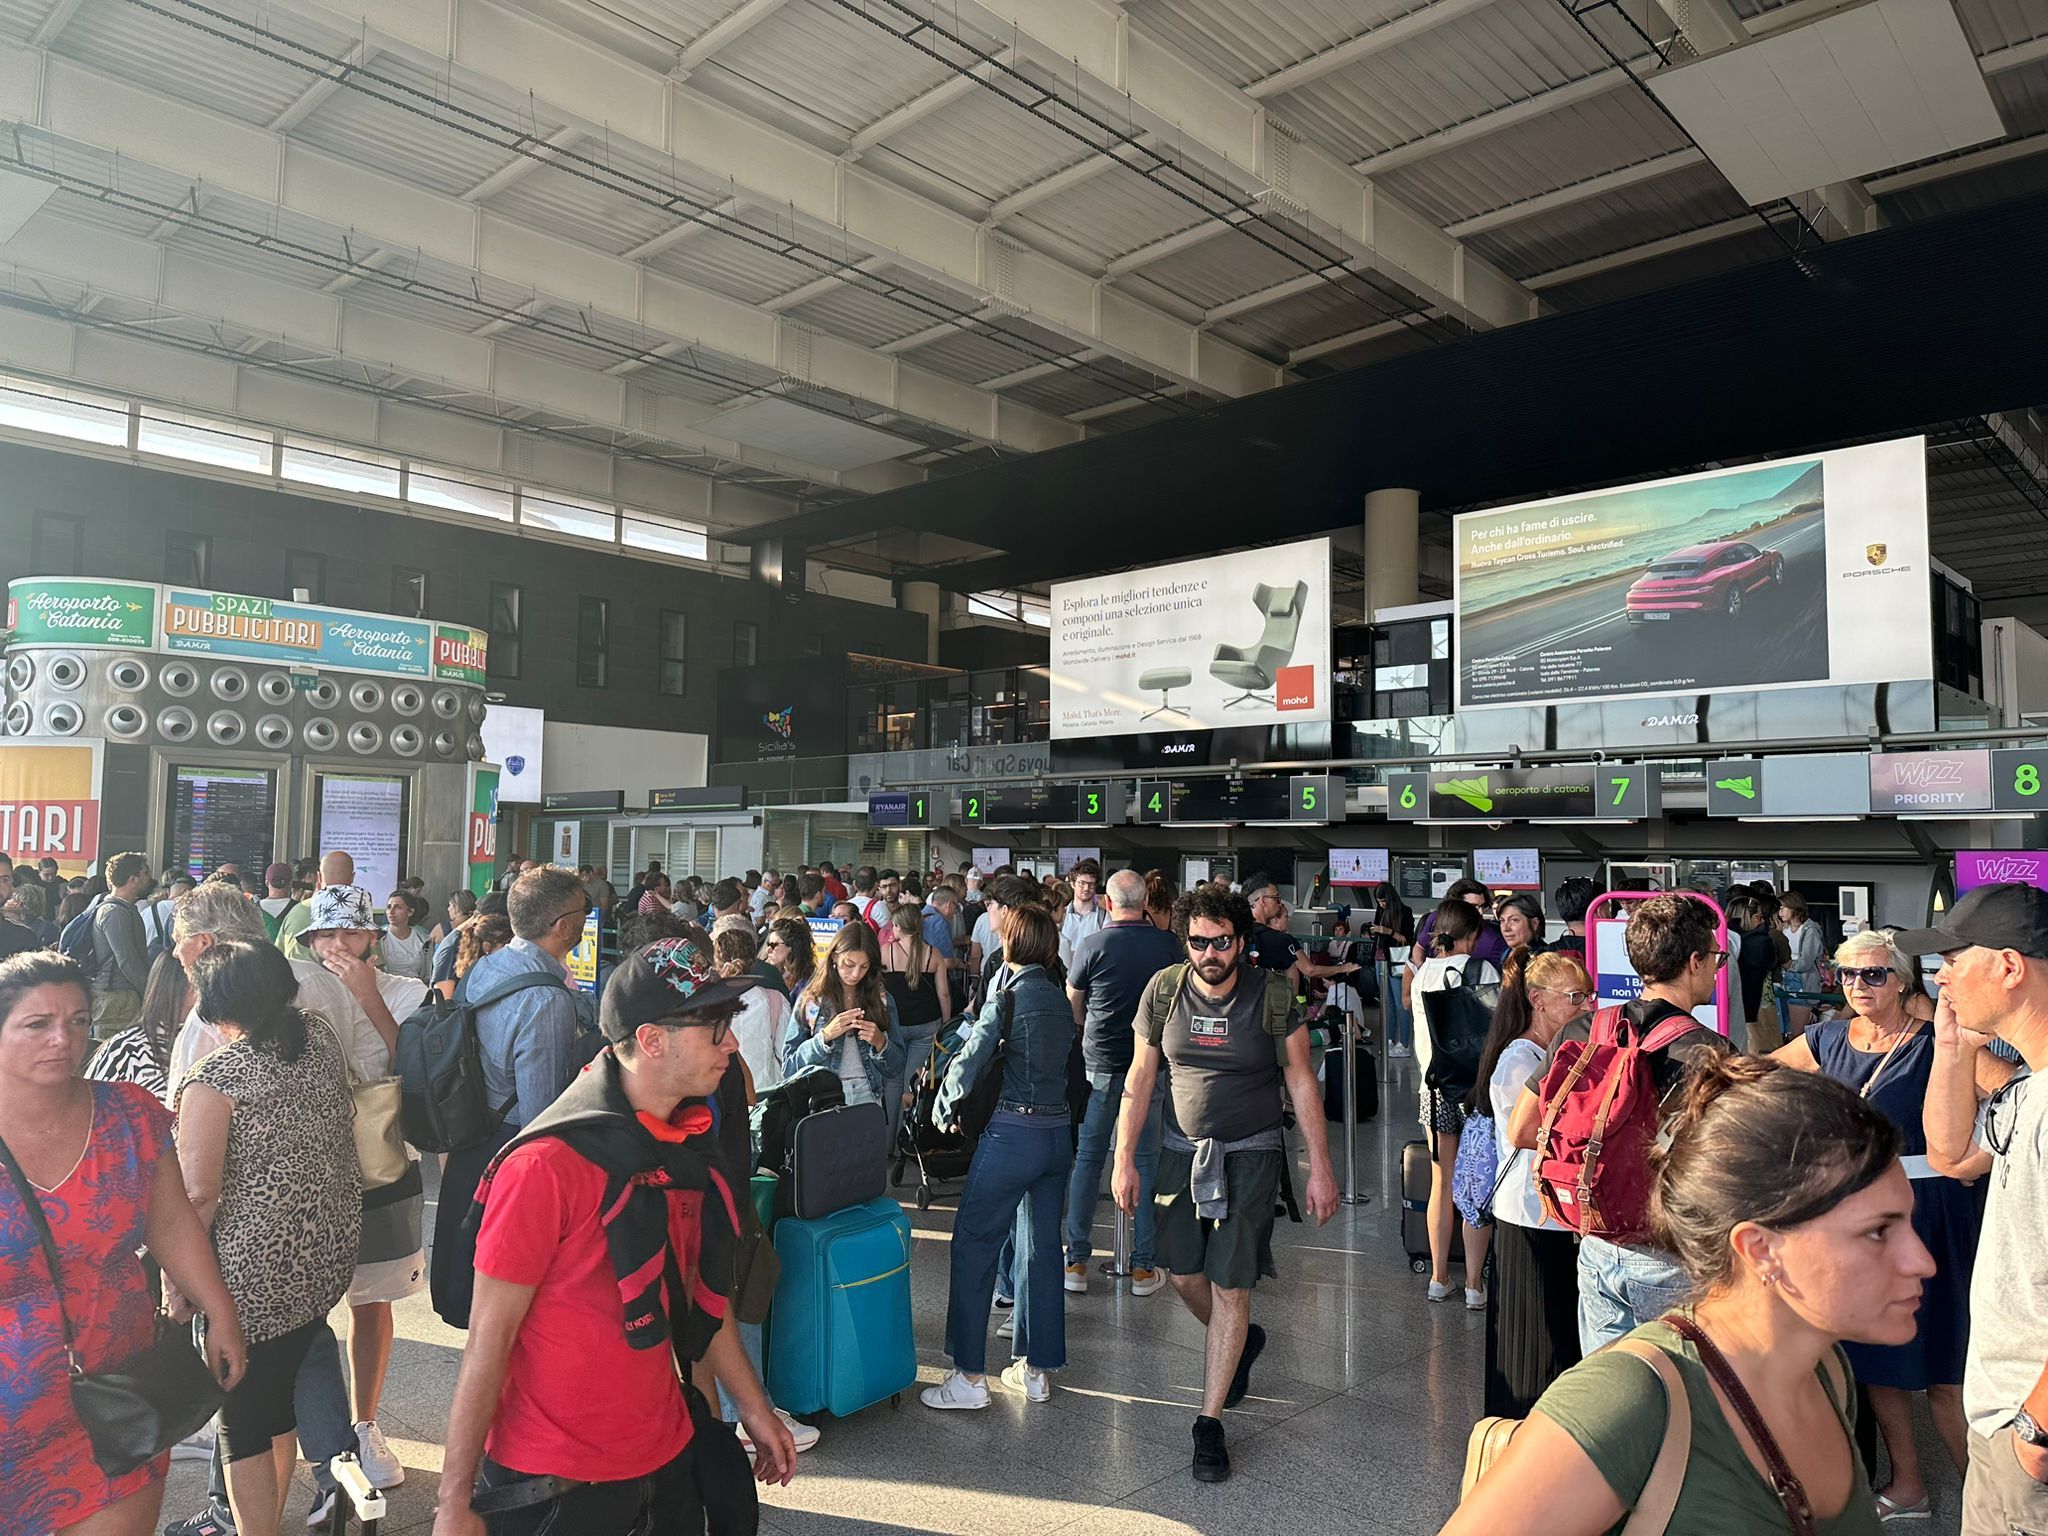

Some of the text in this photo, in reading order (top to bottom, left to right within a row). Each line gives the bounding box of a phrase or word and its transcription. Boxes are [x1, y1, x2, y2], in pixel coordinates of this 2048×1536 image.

[1471, 512, 1597, 541] Per chi ha fame di uscire.
[1471, 530, 1574, 555] Anche dall'ordinario.
[1471, 539, 1625, 568] Nuova Taycan Cross Turismo. Soul, electrified.
[1842, 565, 1911, 579] PORSCHE
[27, 592, 122, 613] Aeroporto
[216, 596, 267, 615] SPAZI
[1063, 580, 1208, 613] Esplora le migliori tendenze e
[47, 610, 123, 630] Catania
[1062, 597, 1202, 626] componi una selezione unica
[173, 607, 316, 646] PUBBLICITARI
[329, 622, 413, 645] Aeroporto
[1062, 625, 1113, 641] e originale.
[175, 639, 211, 650] DAMIR
[352, 639, 414, 661] Catania
[1137, 640, 1156, 650] Design
[1157, 636, 1176, 646] Service
[1178, 635, 1187, 644] dal
[1188, 633, 1202, 642] 1968
[1090, 655, 1111, 665] Delivery
[1115, 652, 1136, 660] mohd.it
[1282, 695, 1308, 705] mohd
[1083, 709, 1102, 720] That's
[1647, 713, 1699, 727] DAMIR
[758, 741, 796, 752] Sicilia's
[1164, 743, 1195, 754] DAMIR
[2014, 763, 2040, 796] 8
[1302, 787, 1316, 810] 5
[1399, 784, 1417, 809] 6
[1495, 783, 1590, 797] aeroporto di catania
[1611, 777, 1630, 806] 7
[1894, 793, 1965, 804] PRIORITY
[875, 803, 906, 811] RYANAIR
[916, 799, 923, 818] 1
[968, 798, 979, 818] 2
[1087, 793, 1099, 815] 3
[1148, 791, 1162, 813] 4
[1625, 977, 1630, 986] 1
[1611, 989, 1631, 997] non
